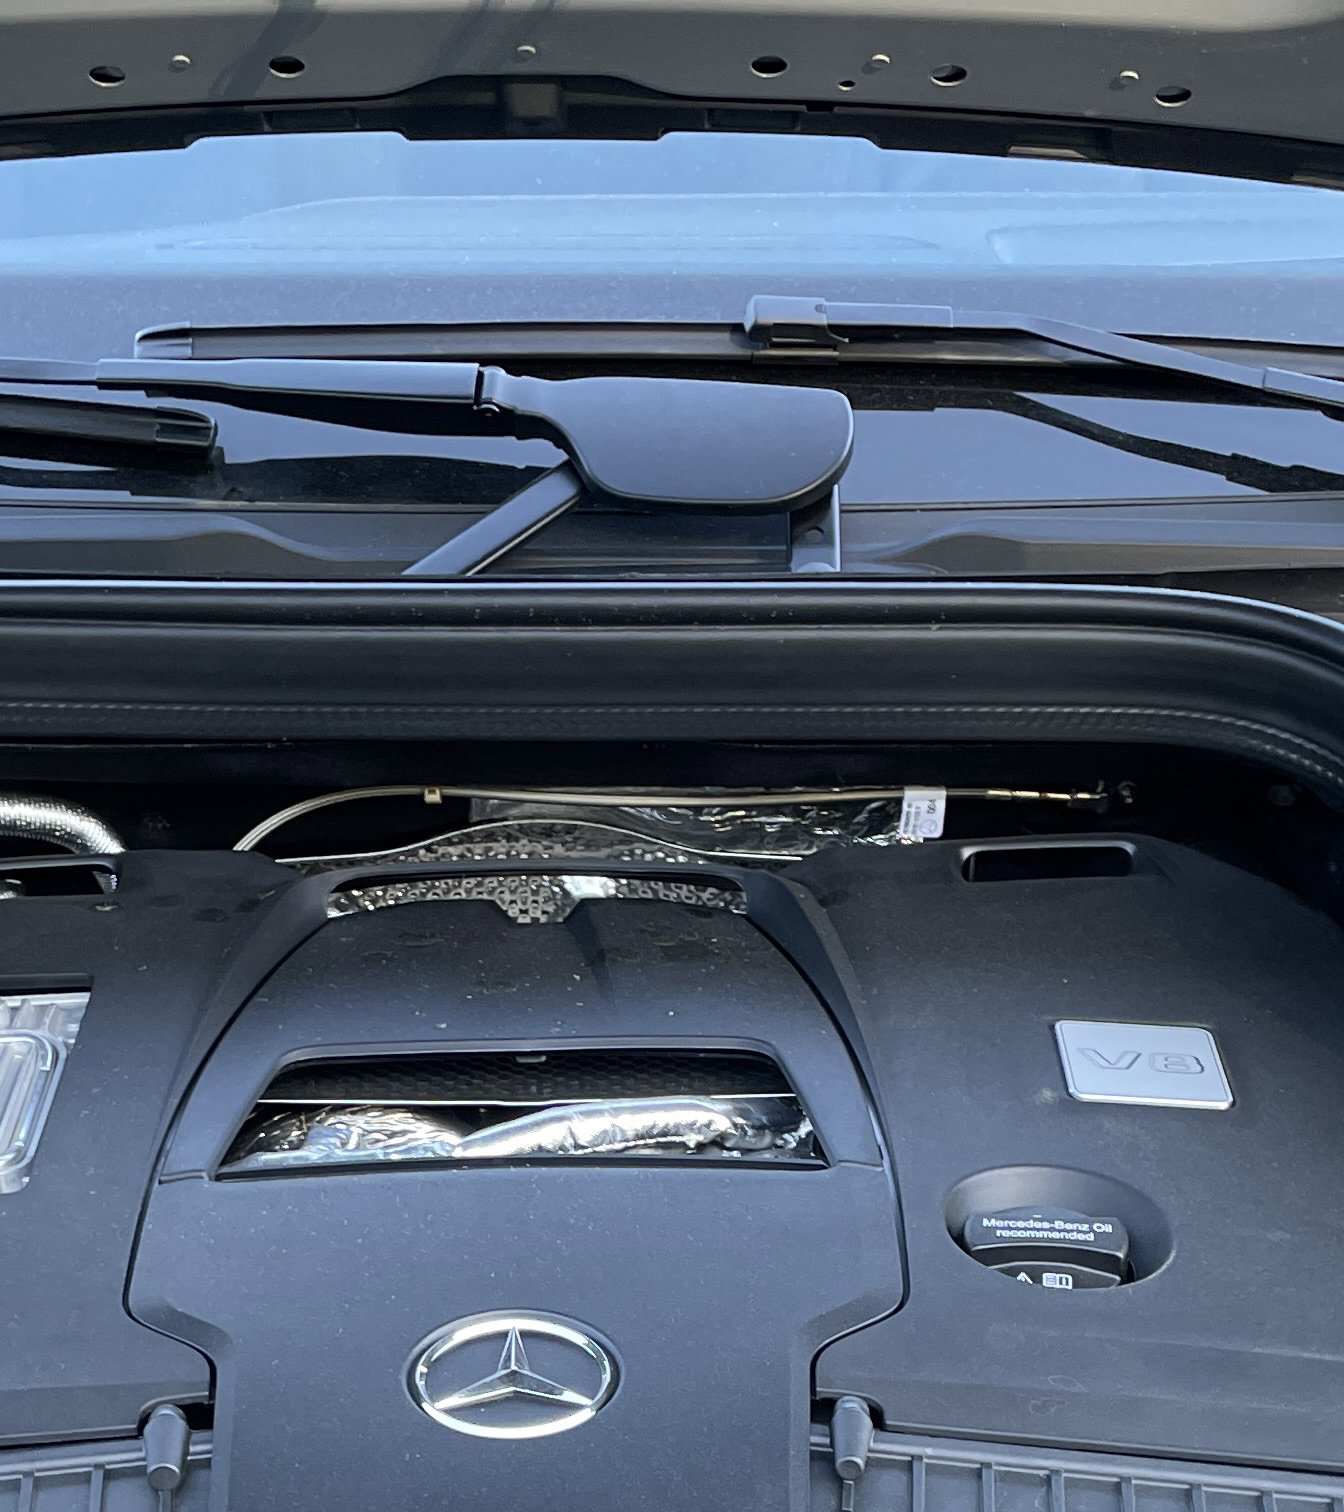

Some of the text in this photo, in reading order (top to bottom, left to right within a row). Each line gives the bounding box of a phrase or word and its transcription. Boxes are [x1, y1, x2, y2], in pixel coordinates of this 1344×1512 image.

[1077, 1047, 1205, 1075] V8
[982, 1217, 1113, 1233] Mercedes-Benz Oil
[996, 1229, 1095, 1241] recommended
